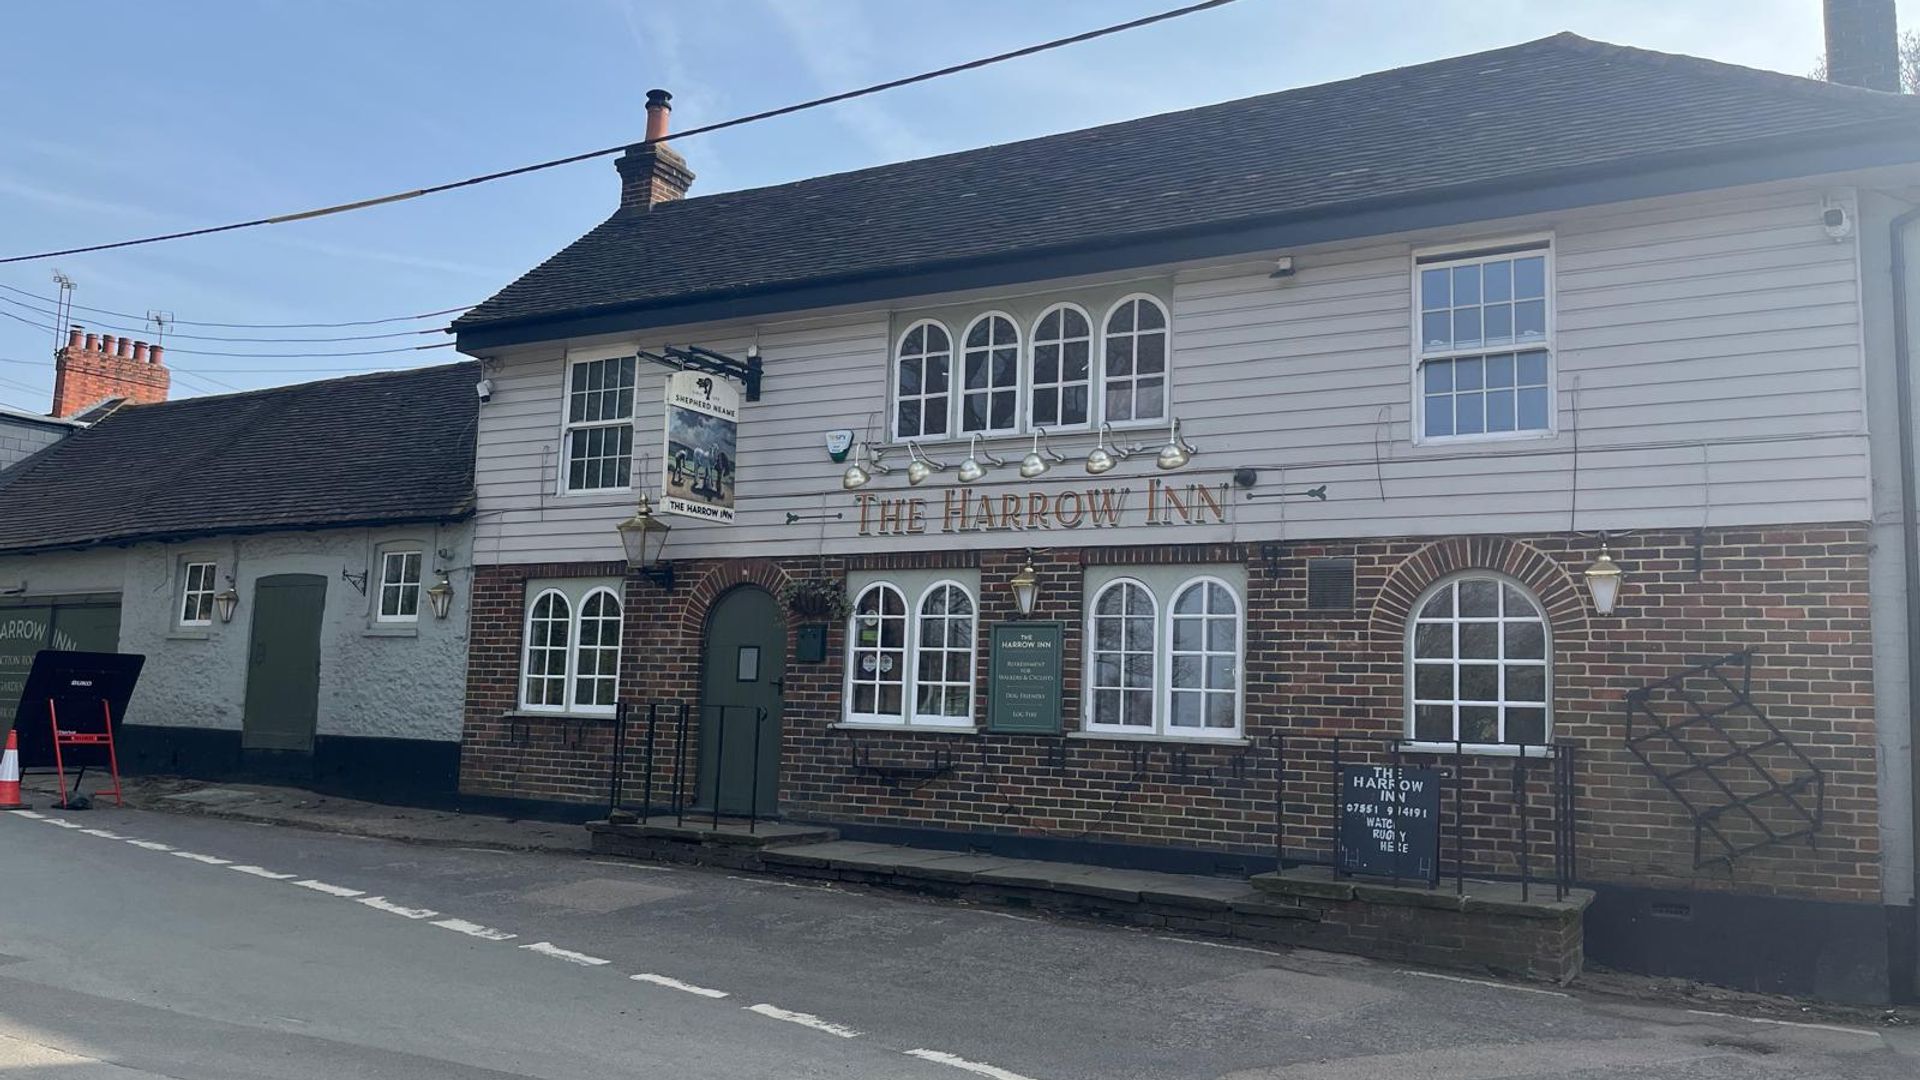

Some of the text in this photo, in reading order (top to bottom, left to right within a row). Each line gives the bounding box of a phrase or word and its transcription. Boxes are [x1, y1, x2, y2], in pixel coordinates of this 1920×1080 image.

[676, 394, 735, 417] SHEPHERD NEAME
[670, 501, 733, 520] THE HARROW INN
[854, 479, 1229, 536] THE HARROW INN
[52, 629, 77, 651] INN
[1373, 766, 1403, 779] THE
[1353, 776, 1424, 792] HARROW
[1380, 790, 1406, 803] INN
[1366, 817, 1396, 829] WATC
